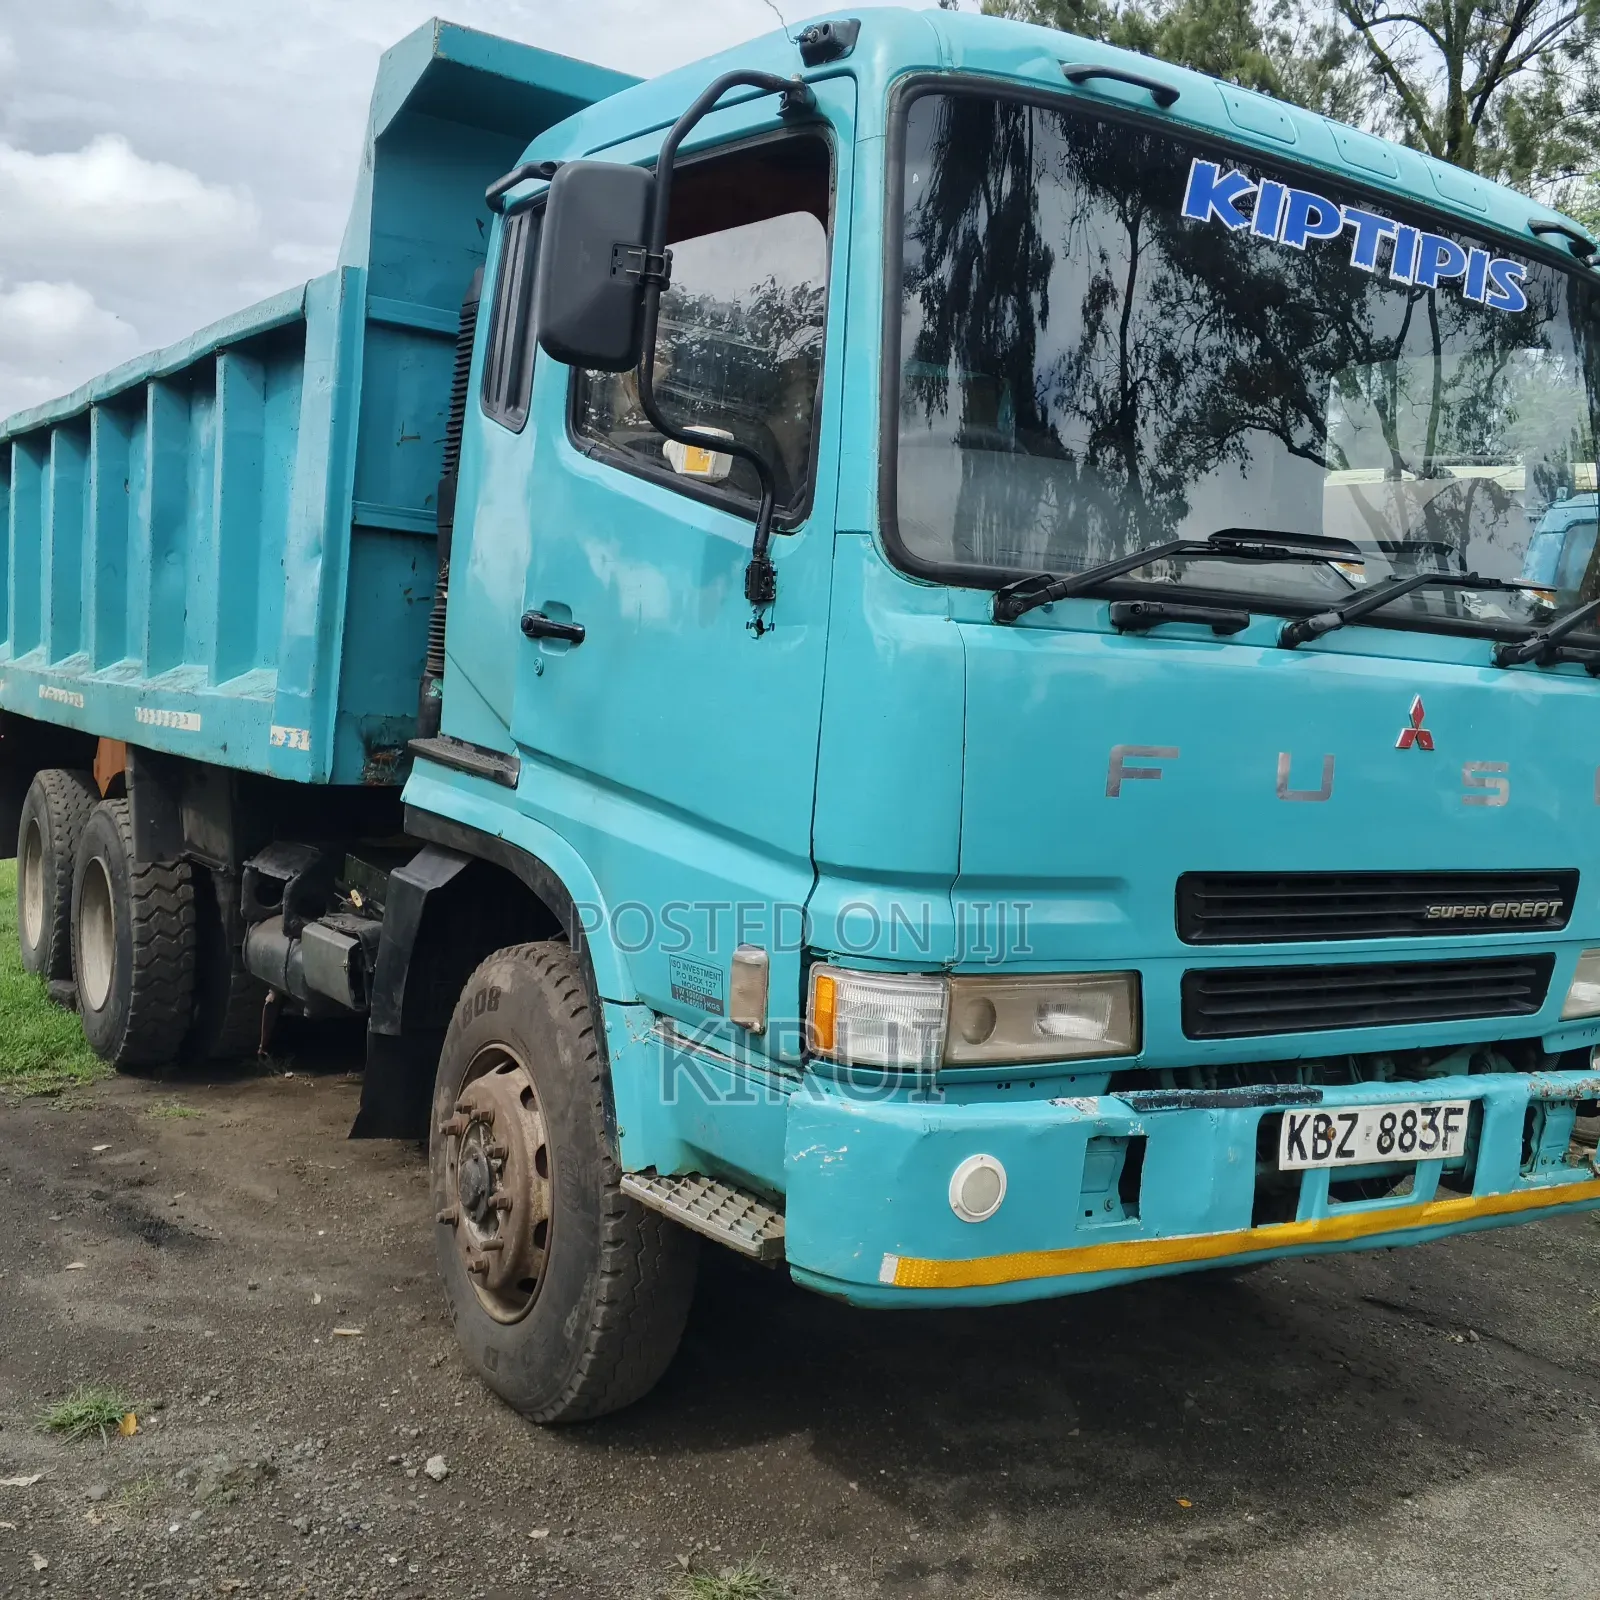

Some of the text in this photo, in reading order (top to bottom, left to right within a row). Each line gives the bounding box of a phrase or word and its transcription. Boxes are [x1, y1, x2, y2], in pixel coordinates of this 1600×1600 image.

[1181, 158, 1527, 312] KIPTIPIS
[1105, 744, 1600, 807] FUS
[1427, 901, 1563, 919] SUPER GREAT
[682, 962, 722, 982] INVESTMENT
[688, 974, 703, 985] BOX
[705, 980, 717, 990] 127
[681, 980, 713, 996] MOGOTIO
[1287, 1112, 1359, 1162] KBZ
[1376, 1106, 1464, 1155] 883F
